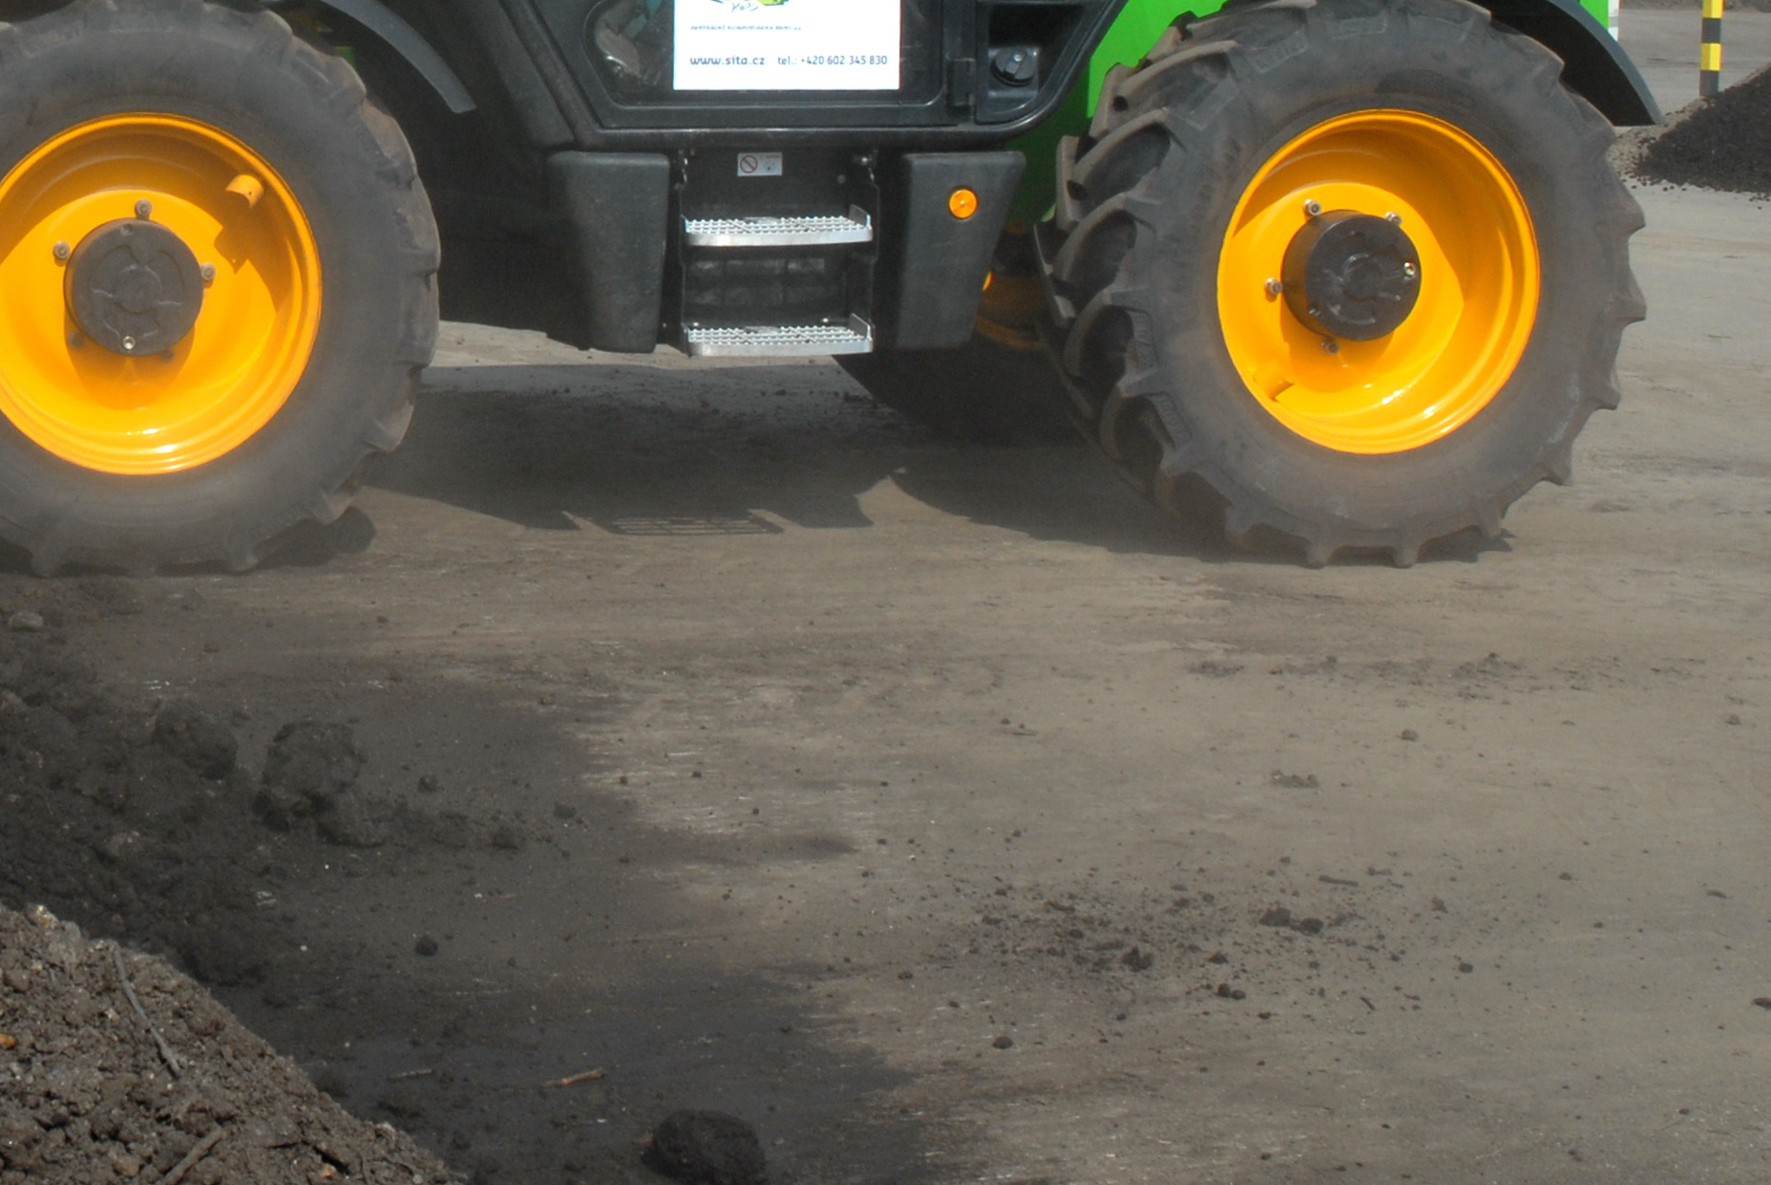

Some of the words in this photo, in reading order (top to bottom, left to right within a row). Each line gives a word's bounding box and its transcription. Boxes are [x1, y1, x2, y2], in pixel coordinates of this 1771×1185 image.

[689, 55, 766, 66] www.sita.cz
[827, 55, 845, 65] 602
[849, 55, 867, 65] 345
[869, 55, 888, 65] 830
